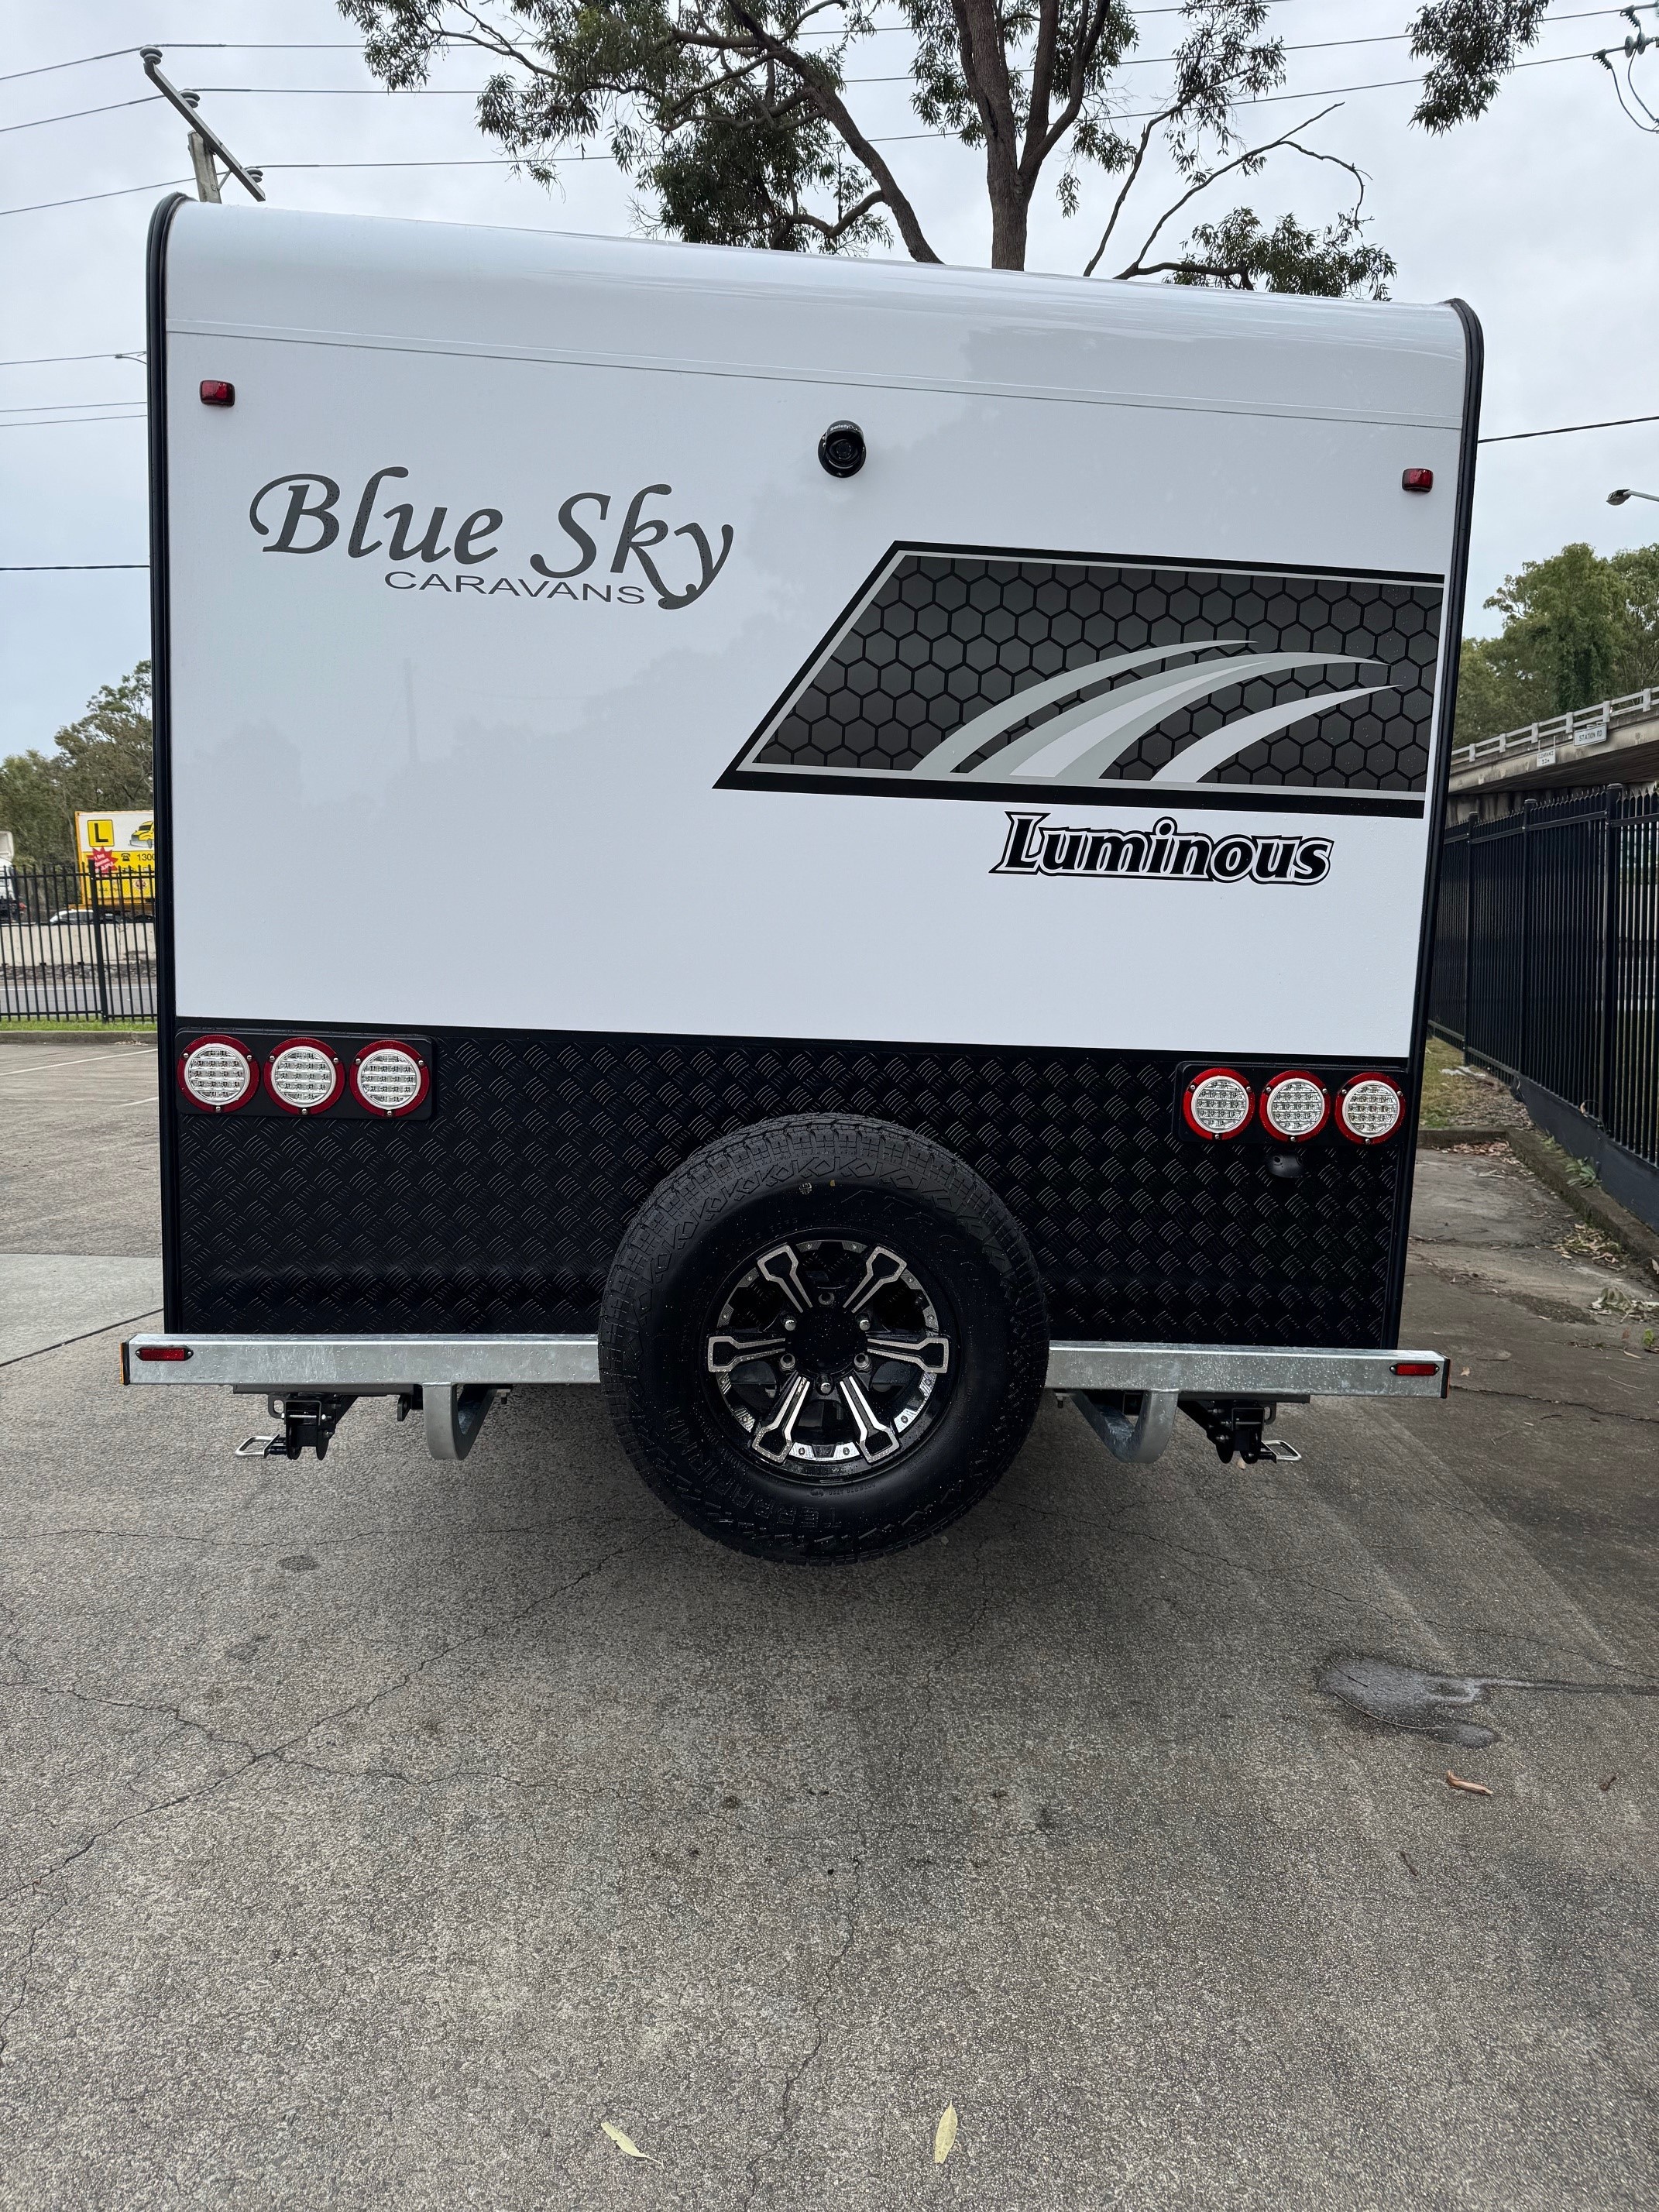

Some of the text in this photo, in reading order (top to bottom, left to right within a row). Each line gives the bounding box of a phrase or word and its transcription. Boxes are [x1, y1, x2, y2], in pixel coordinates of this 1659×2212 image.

[249, 466, 734, 610] Blue Sky
[384, 571, 645, 604] CARAVANS
[1579, 733, 1595, 741] STATION
[94, 823, 108, 843] L
[988, 811, 1334, 885] Luminous
